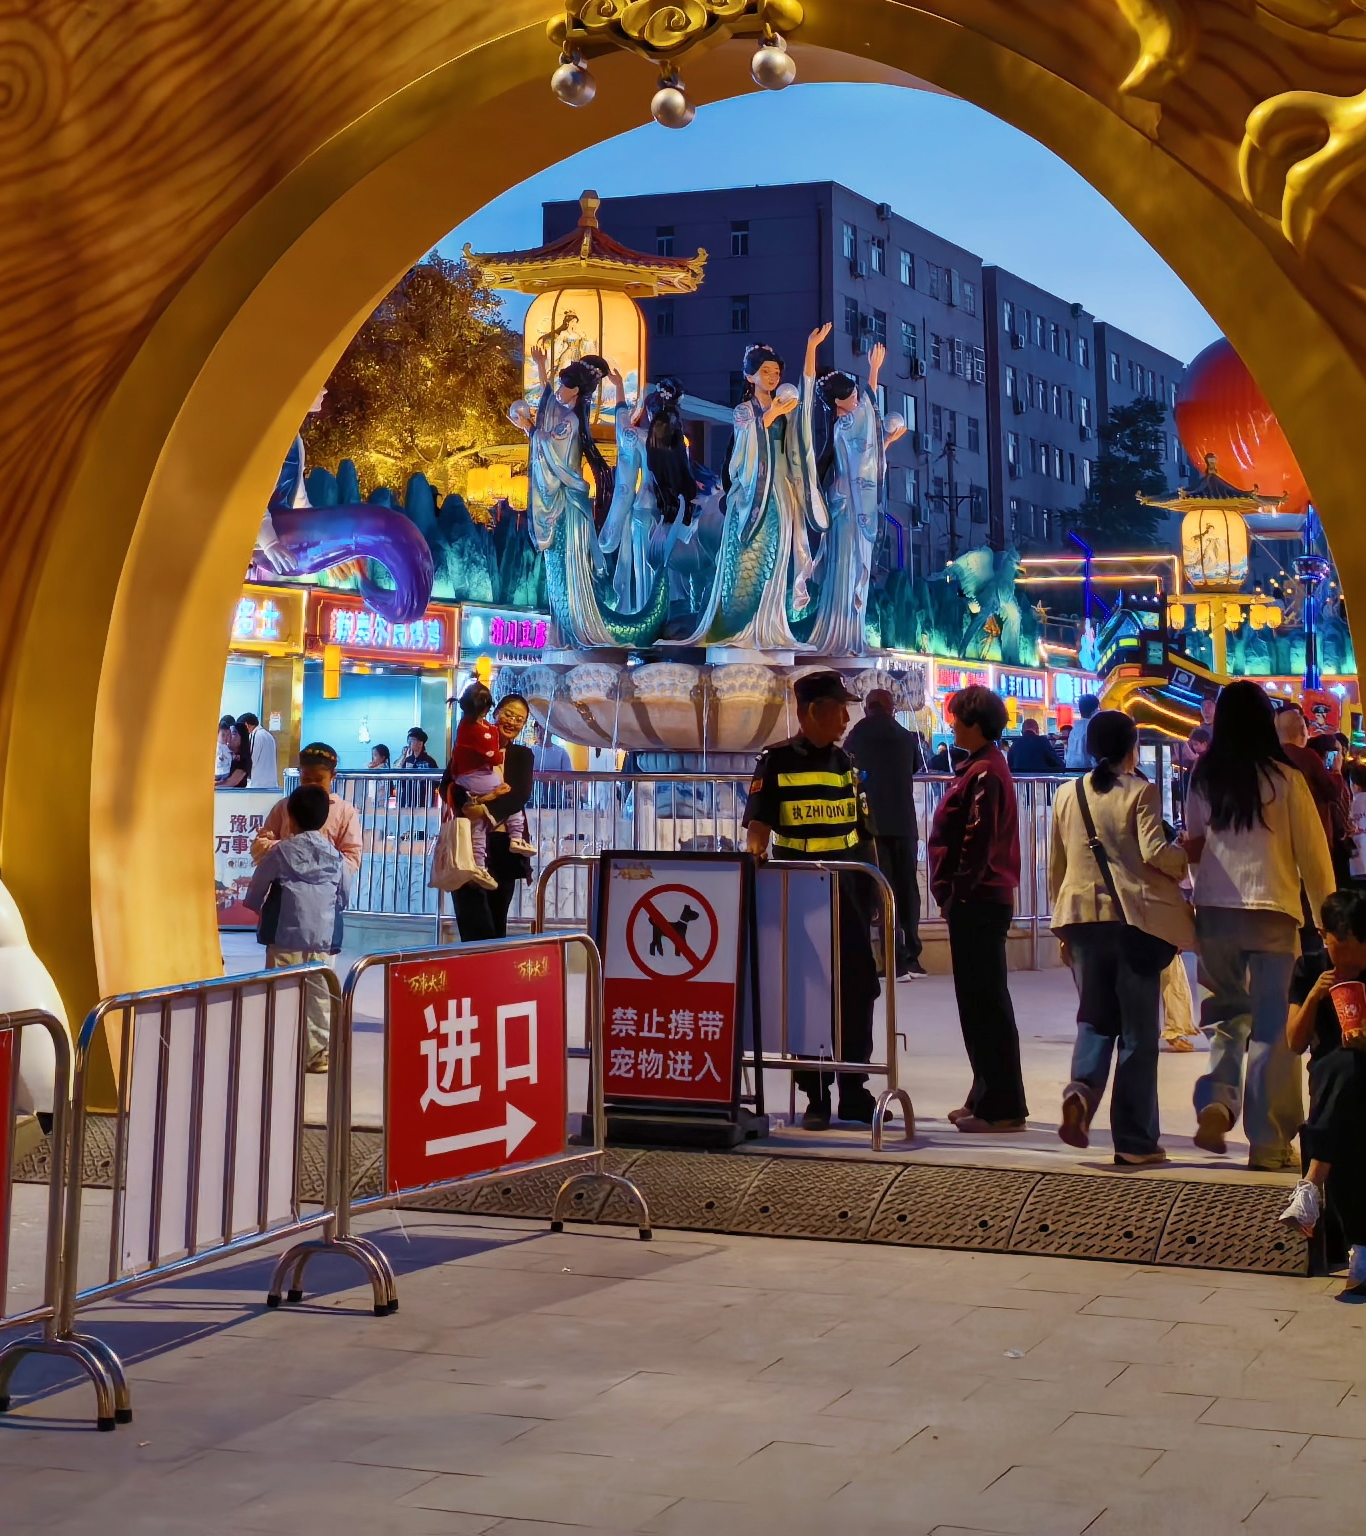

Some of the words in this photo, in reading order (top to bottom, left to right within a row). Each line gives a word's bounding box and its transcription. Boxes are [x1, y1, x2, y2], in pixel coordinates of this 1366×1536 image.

[229, 814, 264, 833] 豫见
[805, 805, 823, 818] ZHI
[826, 805, 845, 818] QIN
[215, 835, 253, 854] 万事
[611, 1007, 724, 1041] 禁止携带
[420, 998, 538, 1113] 进口
[609, 1047, 722, 1082] 宠物进入
